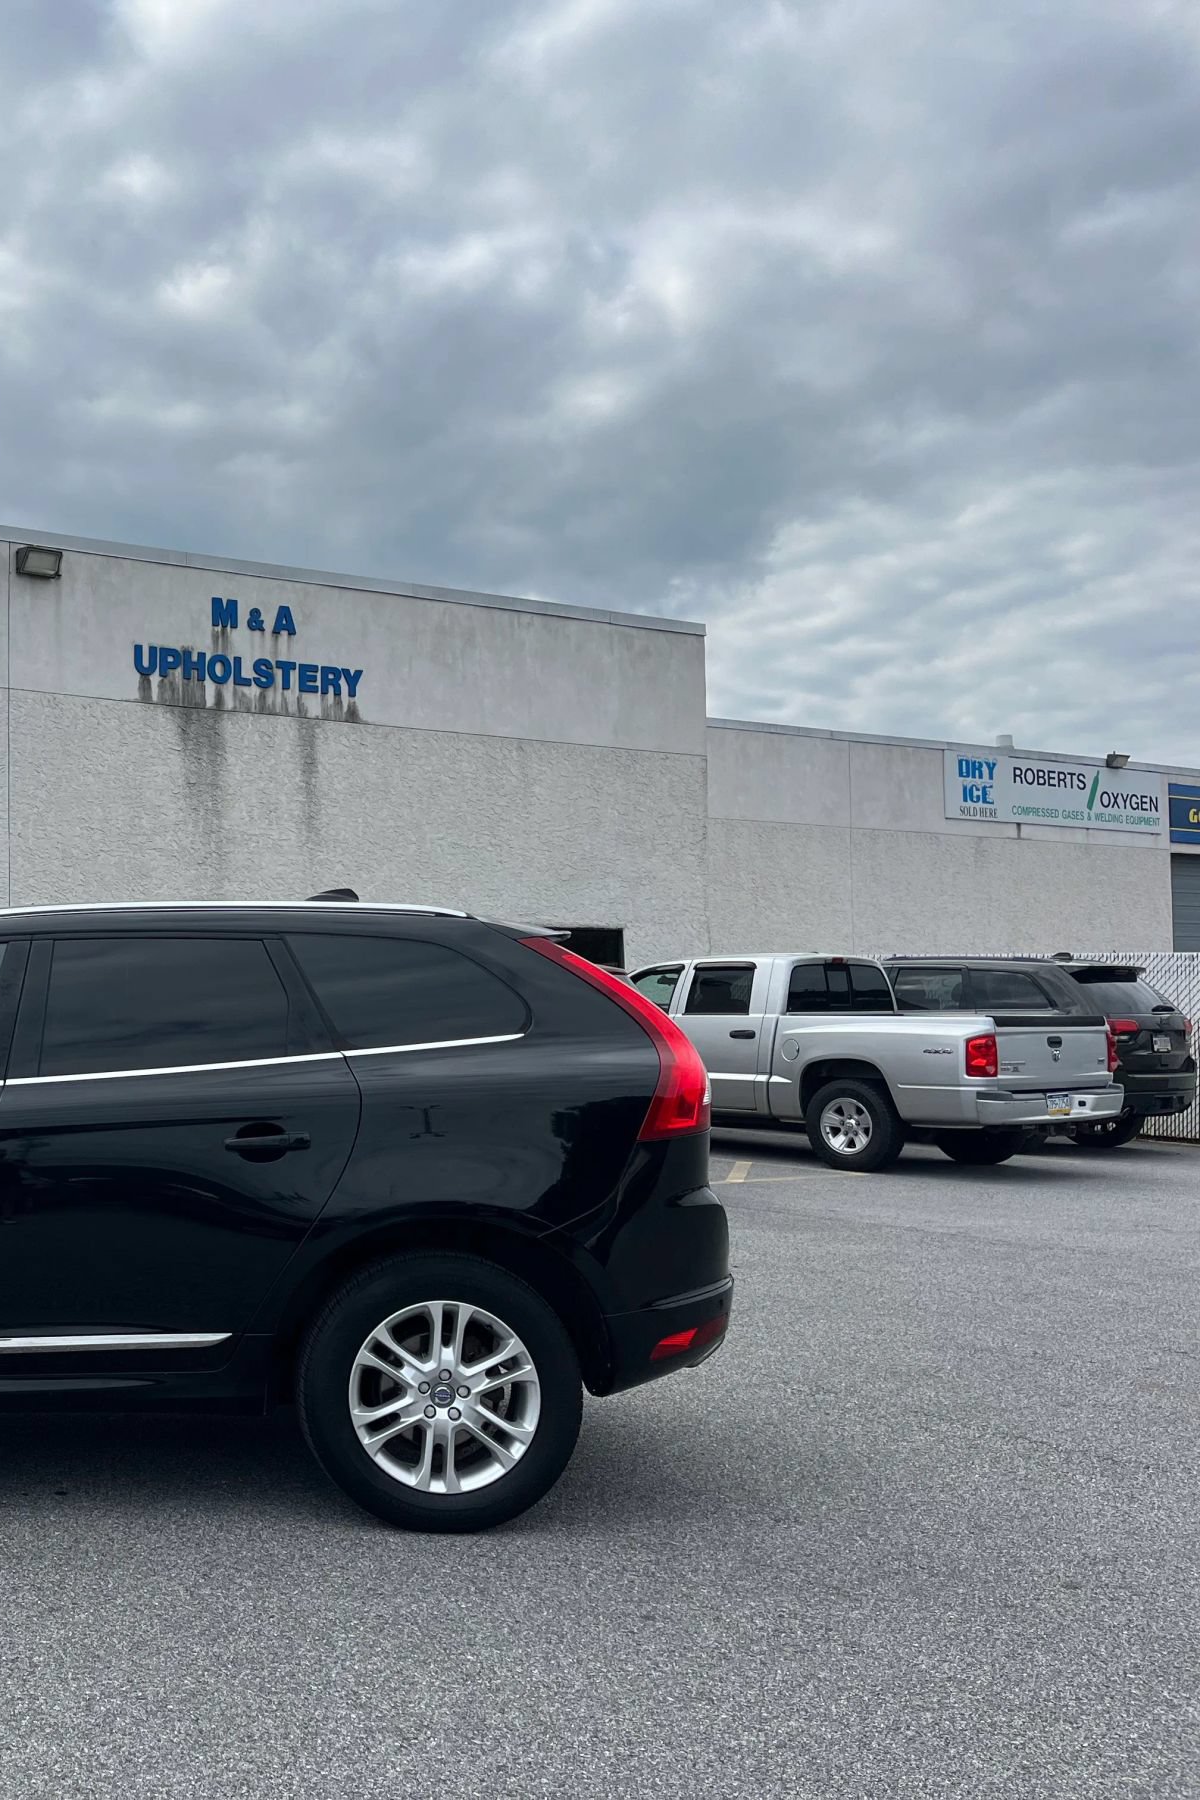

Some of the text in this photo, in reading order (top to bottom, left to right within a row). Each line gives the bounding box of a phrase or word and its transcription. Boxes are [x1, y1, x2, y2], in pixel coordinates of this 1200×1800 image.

[211, 597, 297, 635] M & A
[133, 644, 363, 697] UPHOLSTERY
[957, 755, 998, 780] DRY
[1012, 766, 1087, 790] ROBERTS
[962, 782, 994, 804] ICE
[1099, 791, 1159, 812] OXYGEN
[959, 805, 998, 819] SOLD HERE
[1011, 804, 1161, 827] COMPRESSED GASES & WELDING EQUIPMENT
